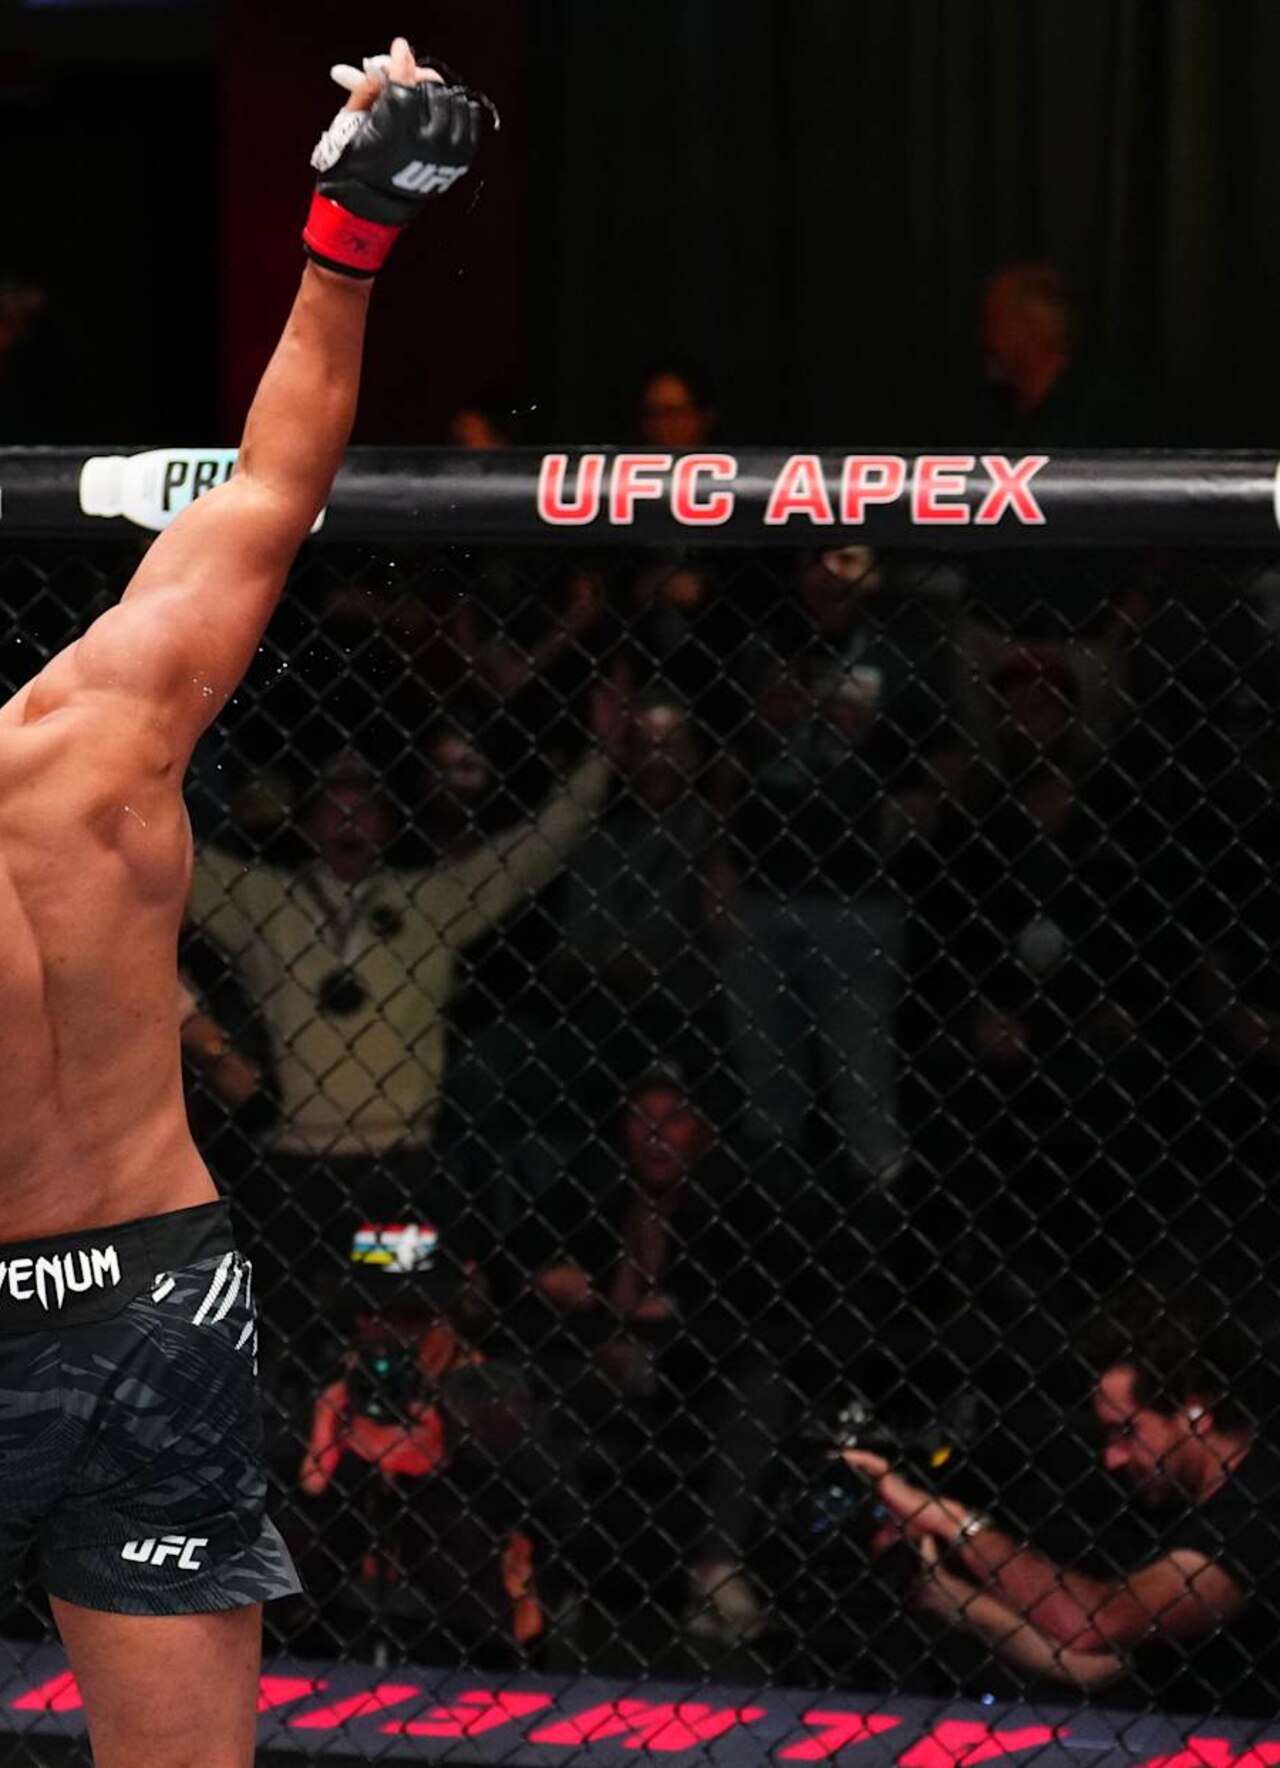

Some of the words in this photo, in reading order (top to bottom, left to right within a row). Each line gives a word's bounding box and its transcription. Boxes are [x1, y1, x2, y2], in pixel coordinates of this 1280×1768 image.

[537, 453, 736, 526] UFC
[764, 453, 1051, 526] APEX
[121, 1535, 209, 1571] UFC
